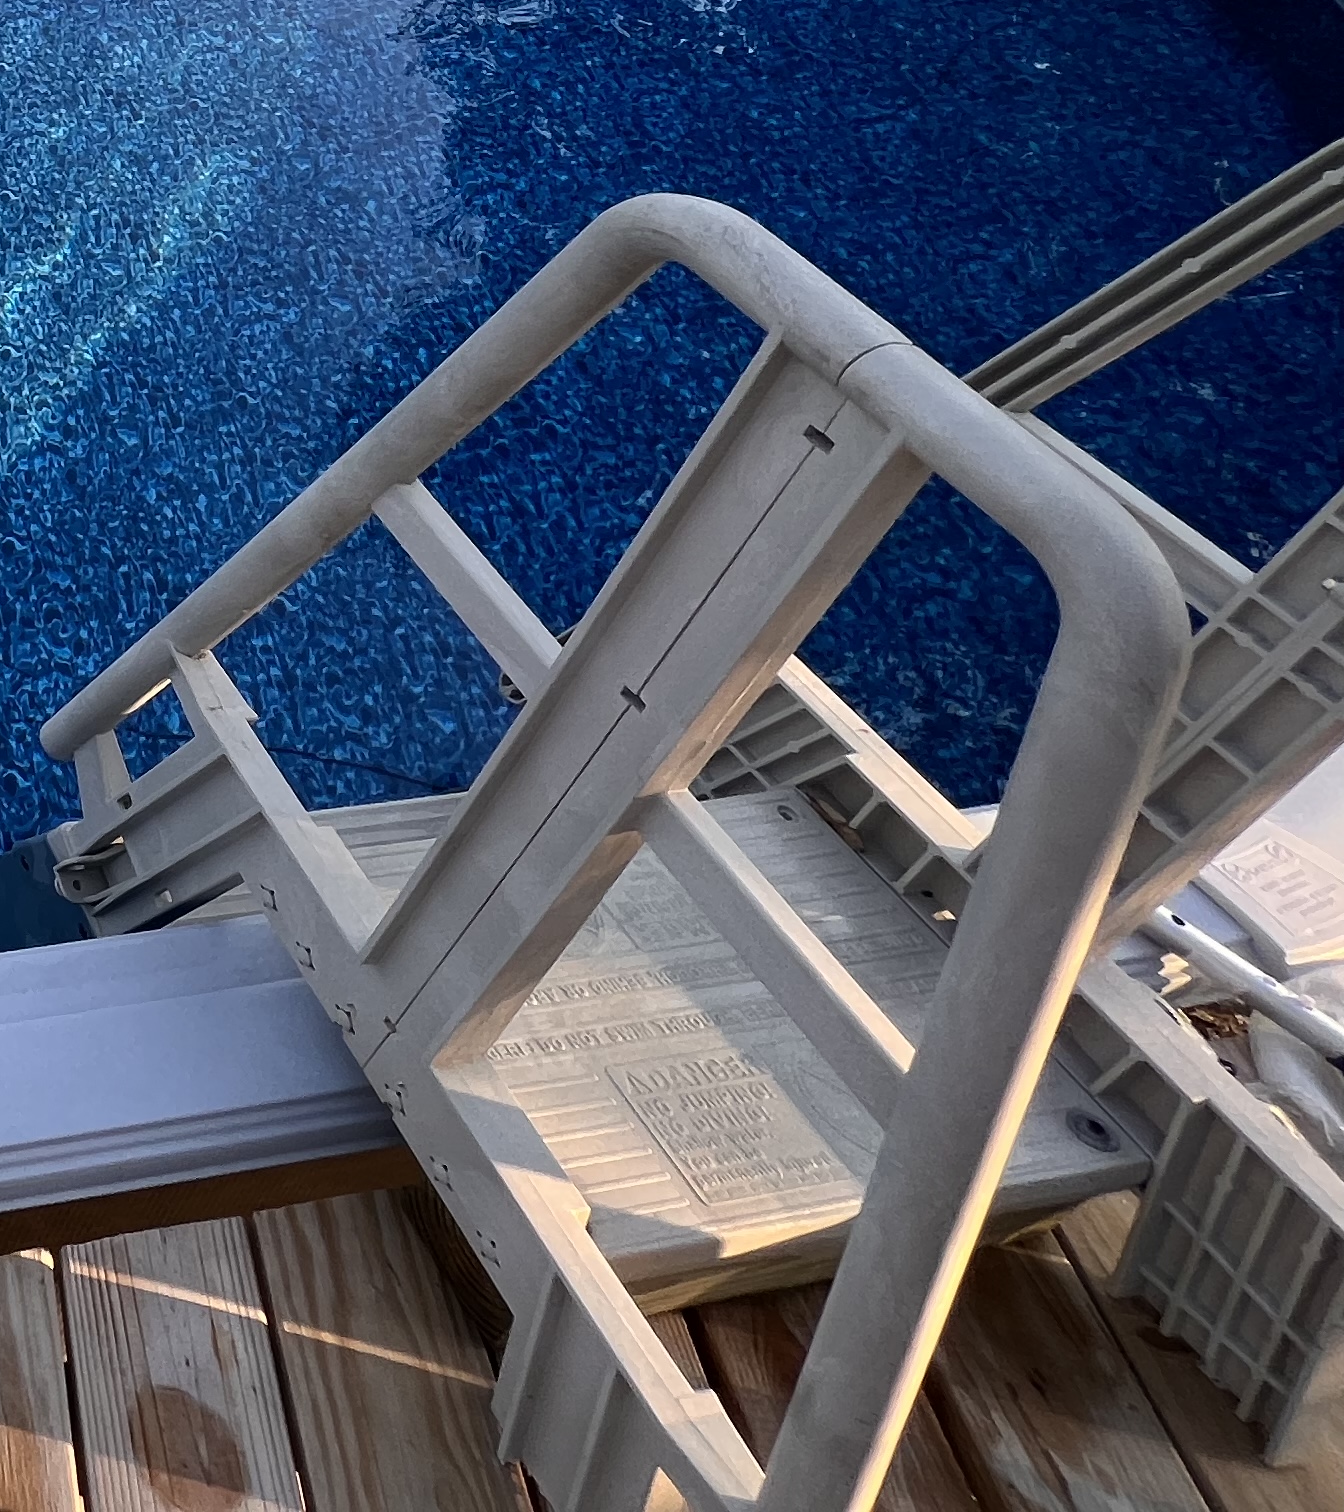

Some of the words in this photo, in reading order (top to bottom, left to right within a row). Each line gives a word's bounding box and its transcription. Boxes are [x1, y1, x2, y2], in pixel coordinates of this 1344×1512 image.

[565, 1028, 602, 1049] NOT
[604, 1021, 654, 1042] SWIM
[648, 1055, 770, 1090] DANGER
[637, 1098, 674, 1120] NO
[651, 1119, 689, 1139] NO
[689, 1105, 775, 1133] DIVING!
